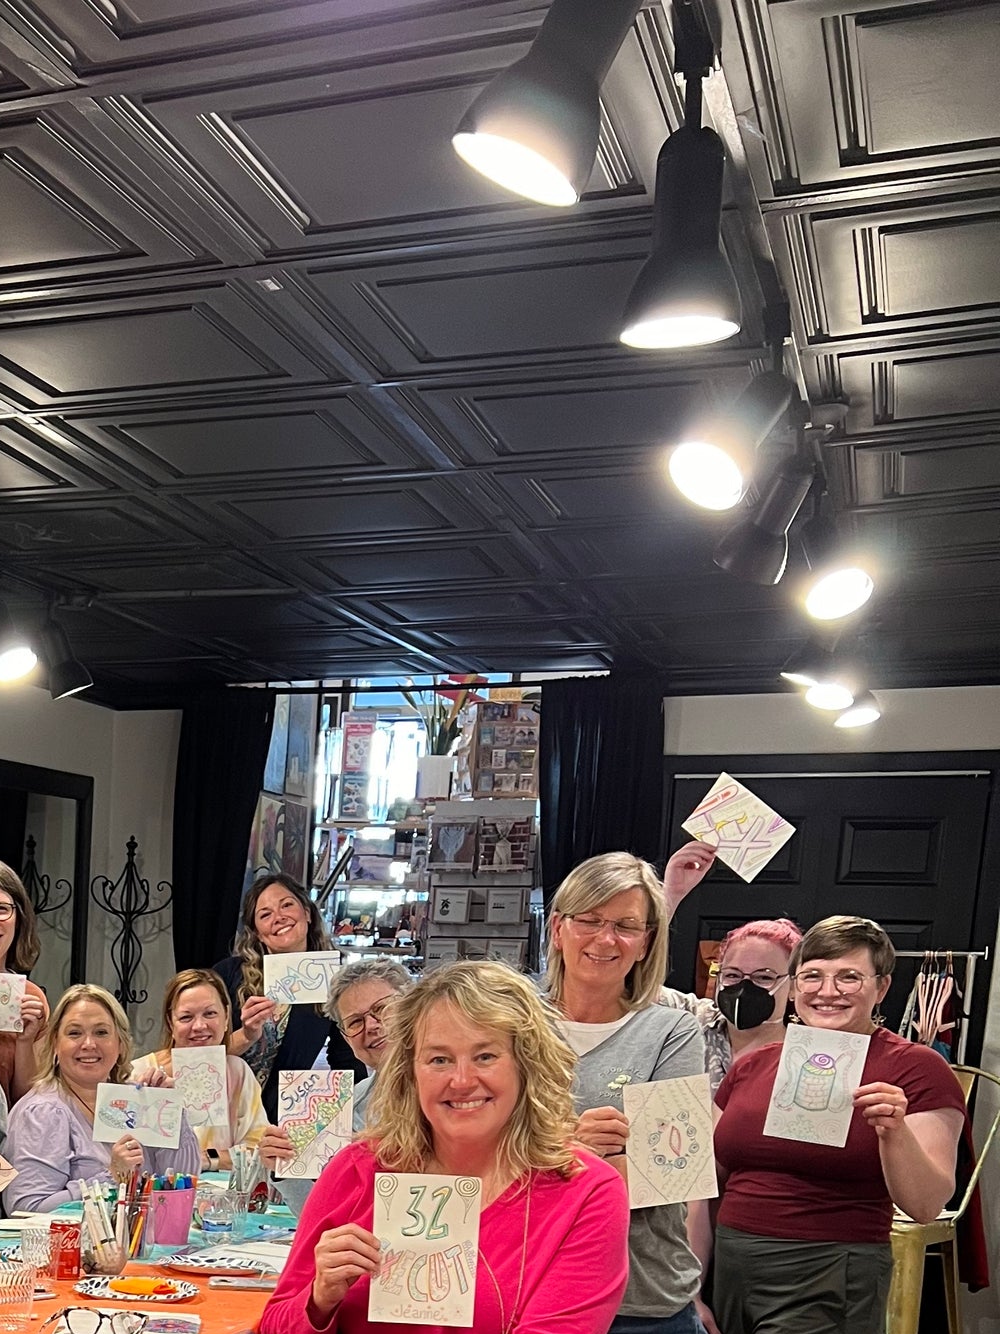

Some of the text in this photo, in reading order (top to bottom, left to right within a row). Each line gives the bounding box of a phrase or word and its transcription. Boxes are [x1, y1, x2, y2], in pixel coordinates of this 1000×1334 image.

[280, 1074, 321, 1112] Susan
[401, 1185, 453, 1240] 32
[389, 1304, 445, 1322] Jeanne
